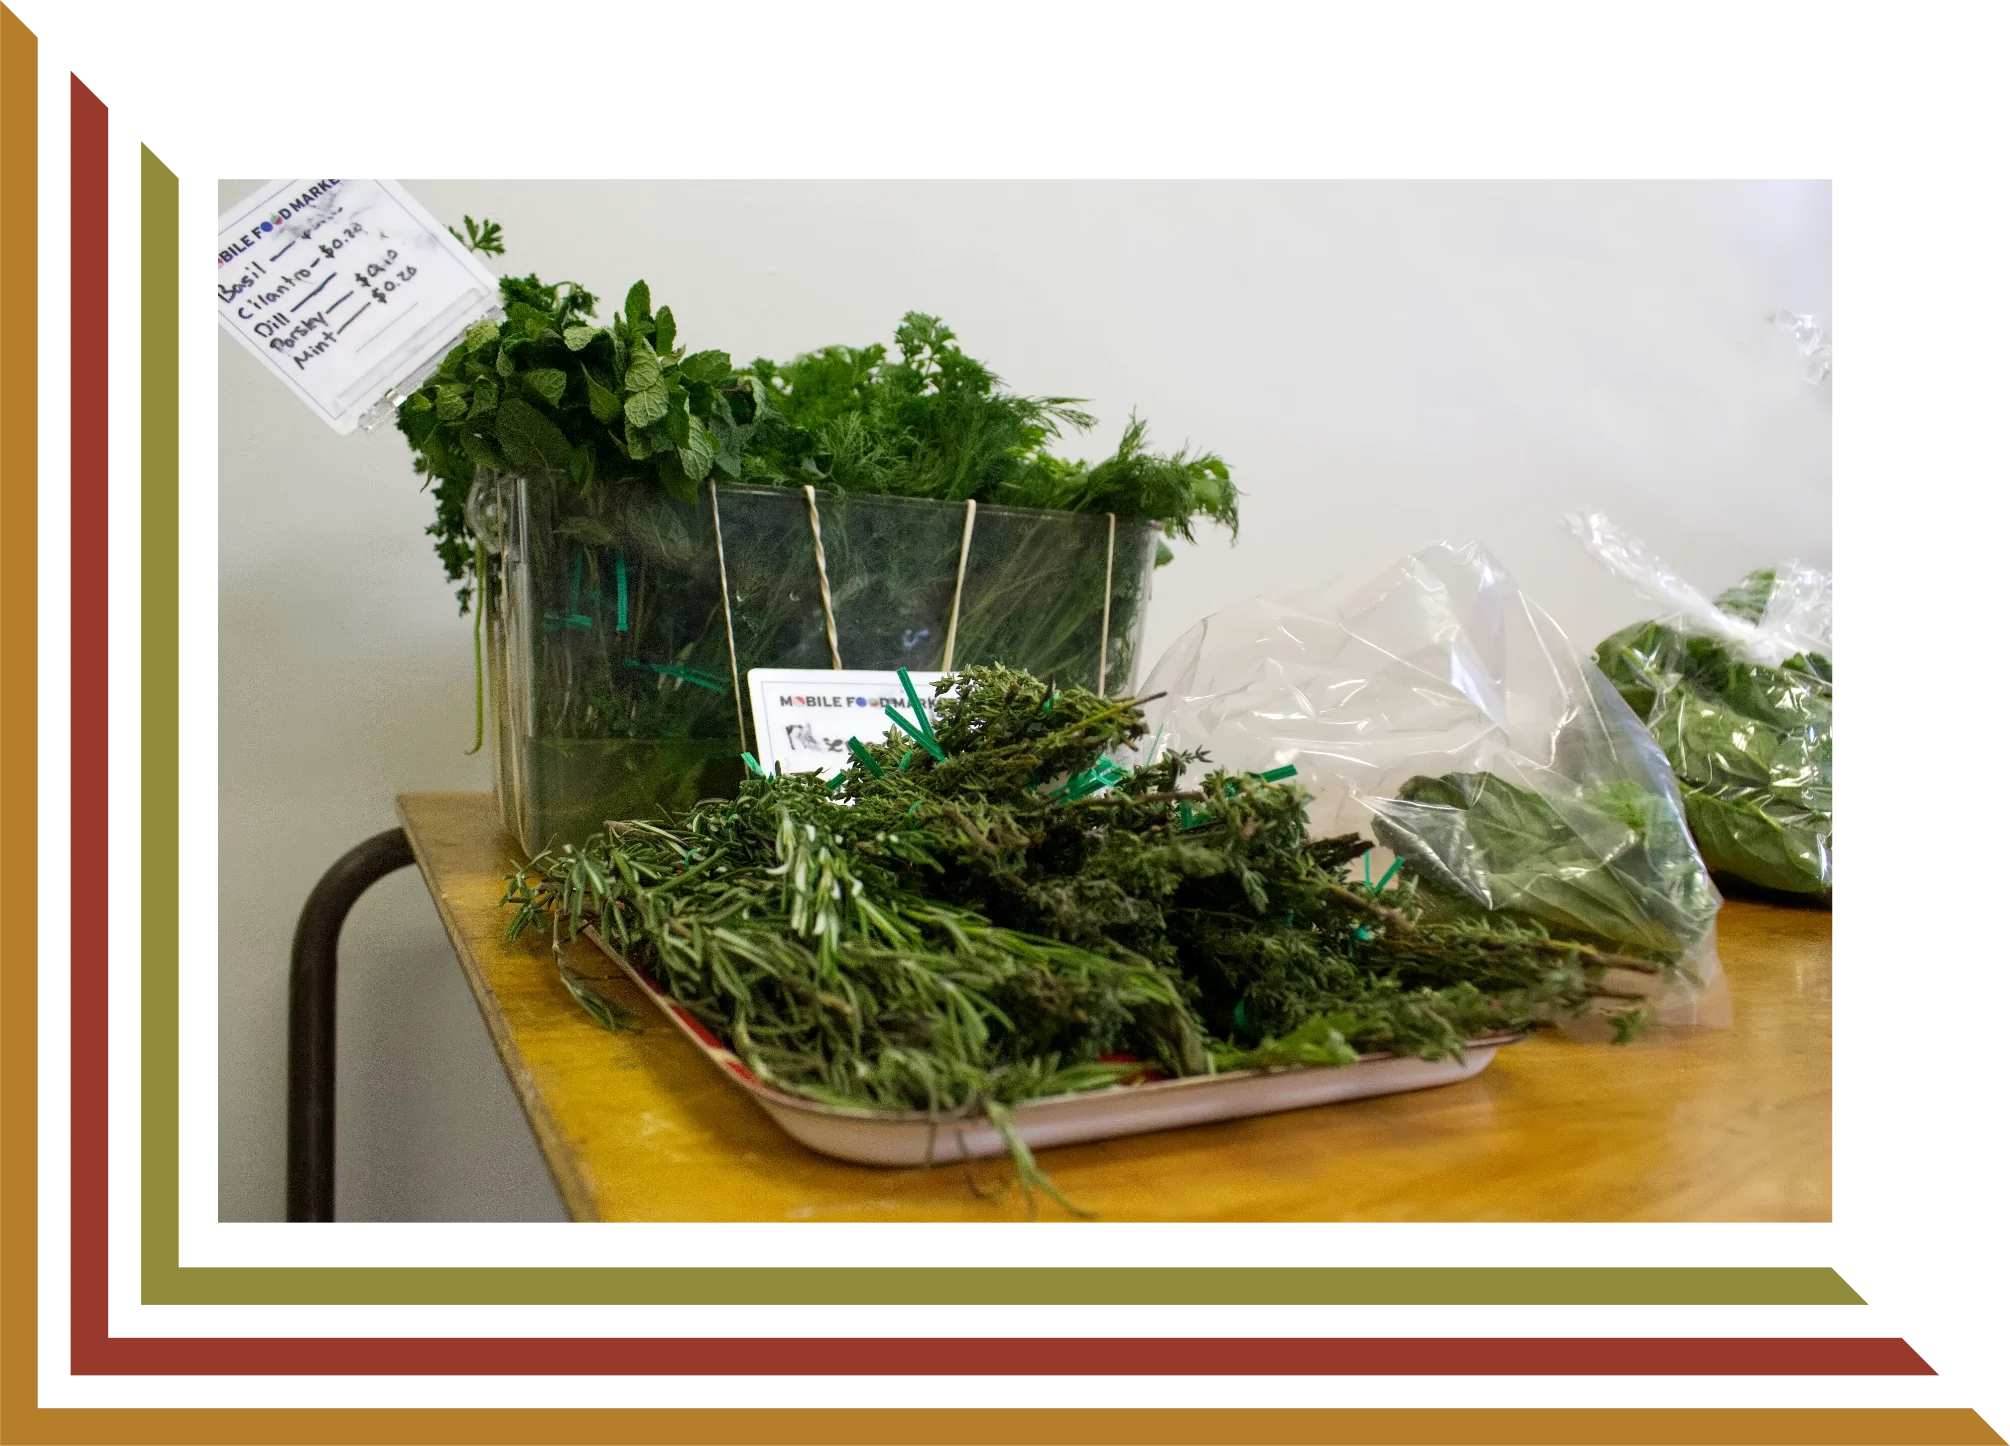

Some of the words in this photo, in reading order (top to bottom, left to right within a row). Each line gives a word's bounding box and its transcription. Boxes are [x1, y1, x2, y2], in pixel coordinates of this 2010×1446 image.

[251, 208, 292, 240] FOOD
[216, 261, 267, 303] Basil
[238, 268, 311, 320] Cilantro
[254, 312, 291, 338] Dill
[293, 331, 337, 370] Mint
[371, 265, 417, 305] $0.20
[780, 695, 843, 708] MOBILE
[846, 696, 889, 708] FOOD
